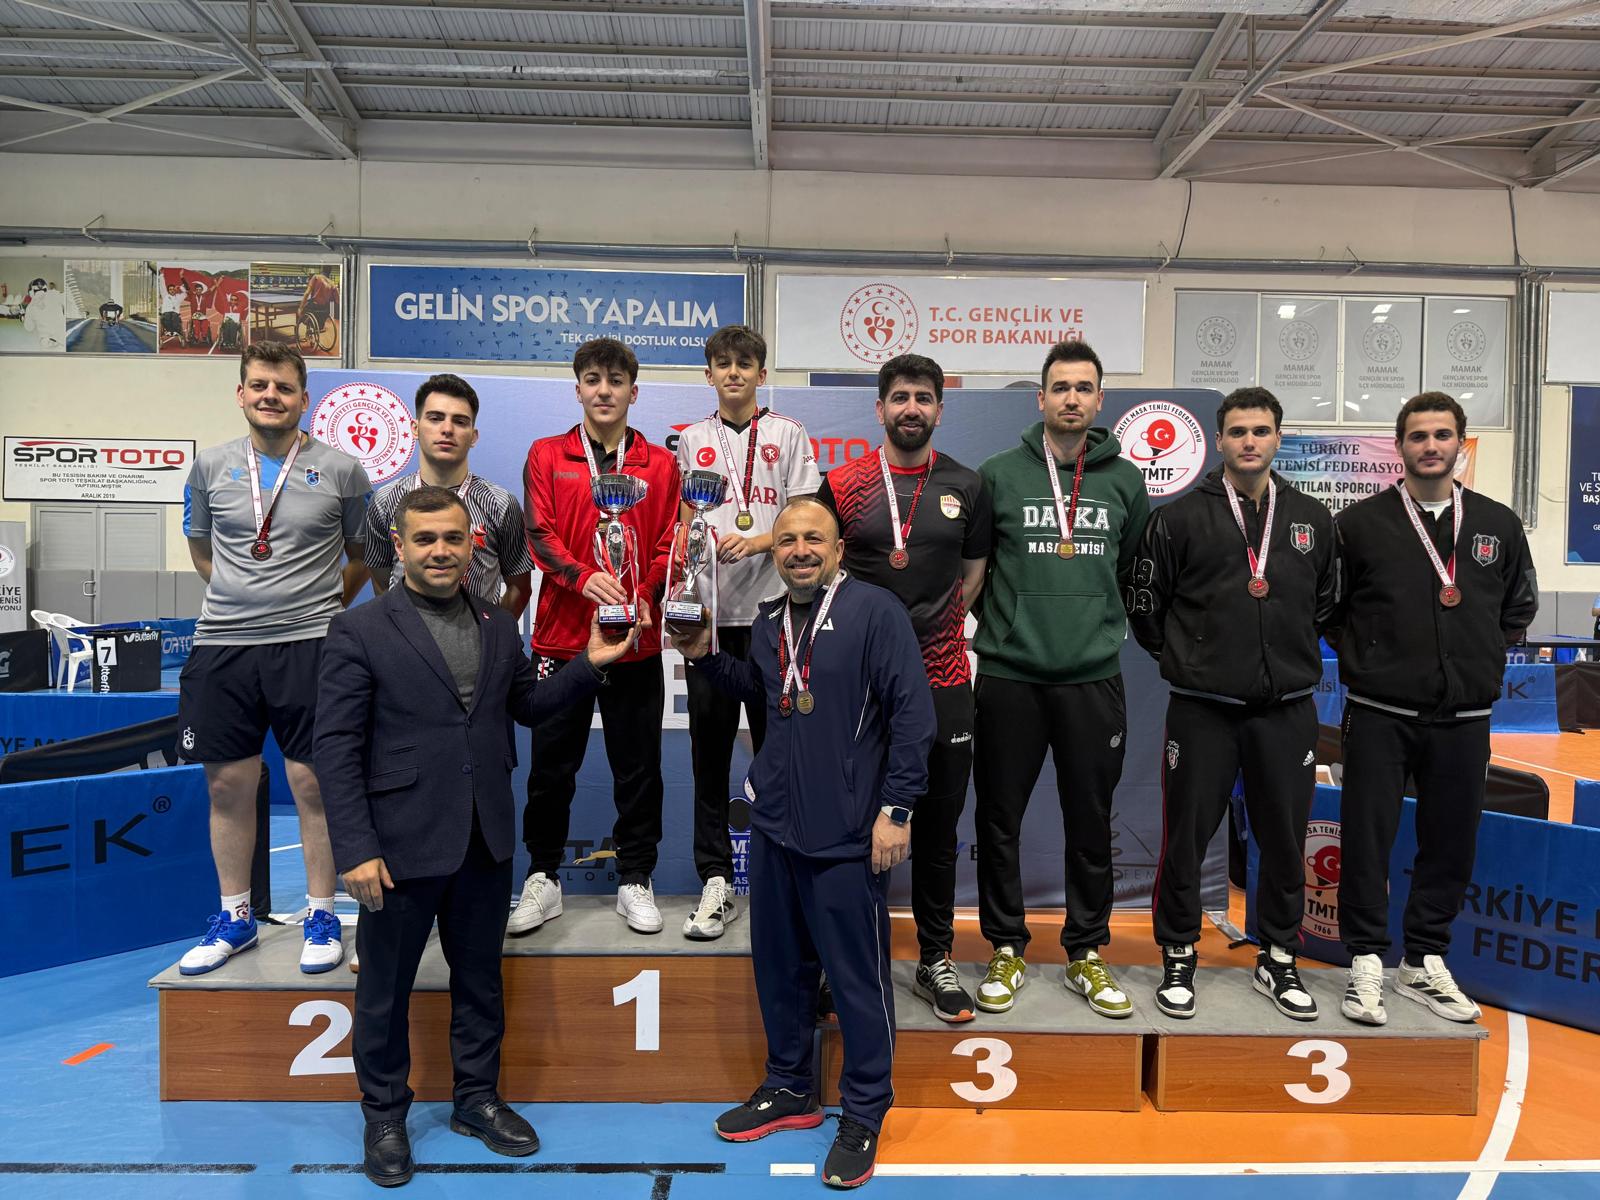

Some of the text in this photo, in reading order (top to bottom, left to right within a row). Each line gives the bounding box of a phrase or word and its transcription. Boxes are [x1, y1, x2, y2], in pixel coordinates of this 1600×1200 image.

[395, 287, 719, 328] GELİN SPOR YAPALIM
[929, 305, 1083, 326] T.C. GENÇLİK VE
[560, 333, 581, 343] TEK
[624, 335, 677, 346] DOSTLUK
[680, 336, 708, 347] OLSU
[929, 328, 977, 344] SPOR
[353, 401, 381, 413] GENÇLİK
[1116, 403, 1202, 443] ÜRKİYE MASA TENİSİ FEDERASYONU
[1301, 441, 1360, 455] TÜRKİYE
[1141, 468, 1174, 481] TMTF
[1275, 458, 1321, 472] TENİSİ
[1335, 482, 1380, 494] SPORCU
[1580, 482, 1592, 492] VE
[1023, 505, 1110, 531] DAKA
[1075, 541, 1105, 555] ENİSİ
[135, 633, 159, 642] Butterfly
[101, 646, 112, 665] 7
[1307, 899, 1338, 920] TMT
[1459, 883, 1578, 935] RKİYE
[612, 969, 660, 1051] 1
[288, 1000, 355, 1077] 2
[950, 1037, 1018, 1103] 3
[1284, 1038, 1351, 1104] 3
